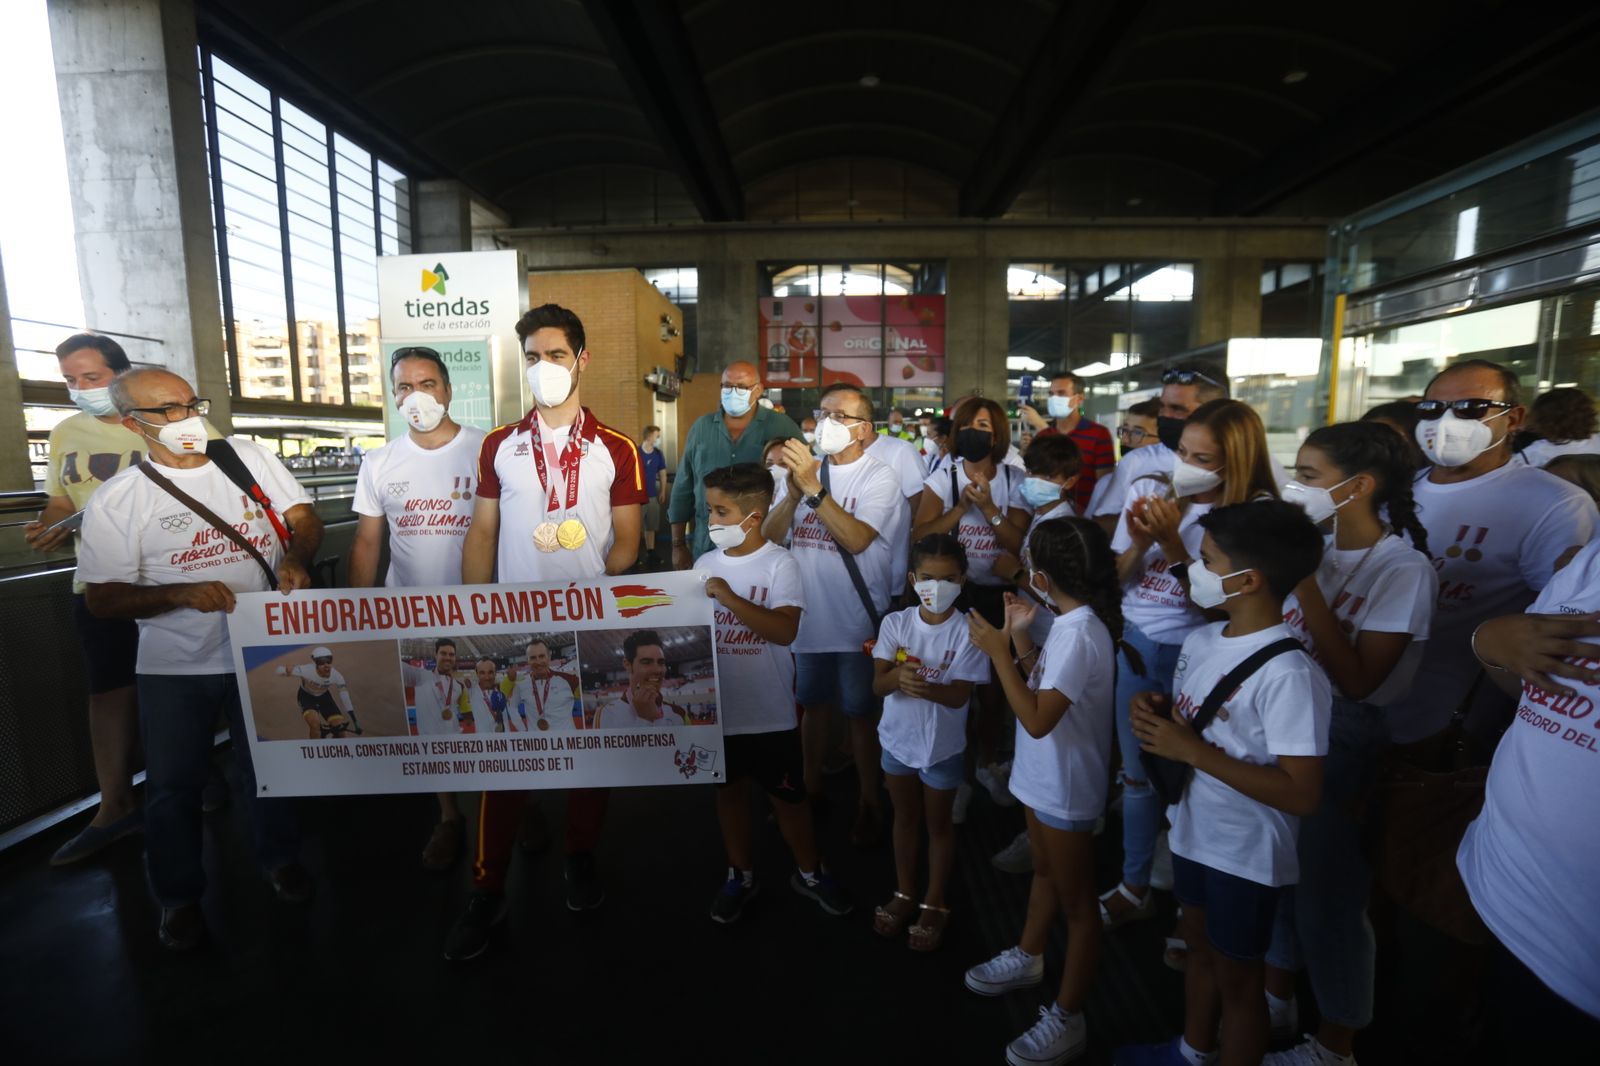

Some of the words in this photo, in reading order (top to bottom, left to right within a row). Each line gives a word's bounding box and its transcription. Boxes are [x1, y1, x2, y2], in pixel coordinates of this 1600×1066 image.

[404, 296, 490, 318] tiendas
[423, 321, 435, 331] de
[437, 320, 446, 330] la
[449, 319, 491, 329] estación
[568, 484, 576, 502] TOKYO
[404, 498, 453, 512] ALFONSO
[427, 514, 472, 528] LLAMAS
[171, 543, 226, 566] CABELLO
[223, 556, 241, 565] DEL
[264, 594, 466, 636] ENHORABUENA
[470, 582, 604, 625] CAMPEÓN
[732, 648, 762, 656] MUNDO!
[300, 746, 315, 759] TU
[317, 744, 354, 759] LUCHA,
[356, 742, 420, 758] CONSTANCIA
[421, 741, 429, 755] Y
[431, 739, 484, 755] ESFUERZO
[486, 738, 508, 754] HAN
[510, 737, 548, 753] TENIDO
[550, 736, 564, 751] LA
[566, 735, 601, 750] MEJOR
[603, 733, 676, 749] RECOMPENSA
[1561, 727, 1599, 753] DEL
[402, 760, 451, 776] ESTAMOS
[453, 759, 476, 774] MUY
[478, 757, 545, 773] ORGULLOSOS
[547, 757, 561, 771] DE
[563, 756, 574, 770] TI
